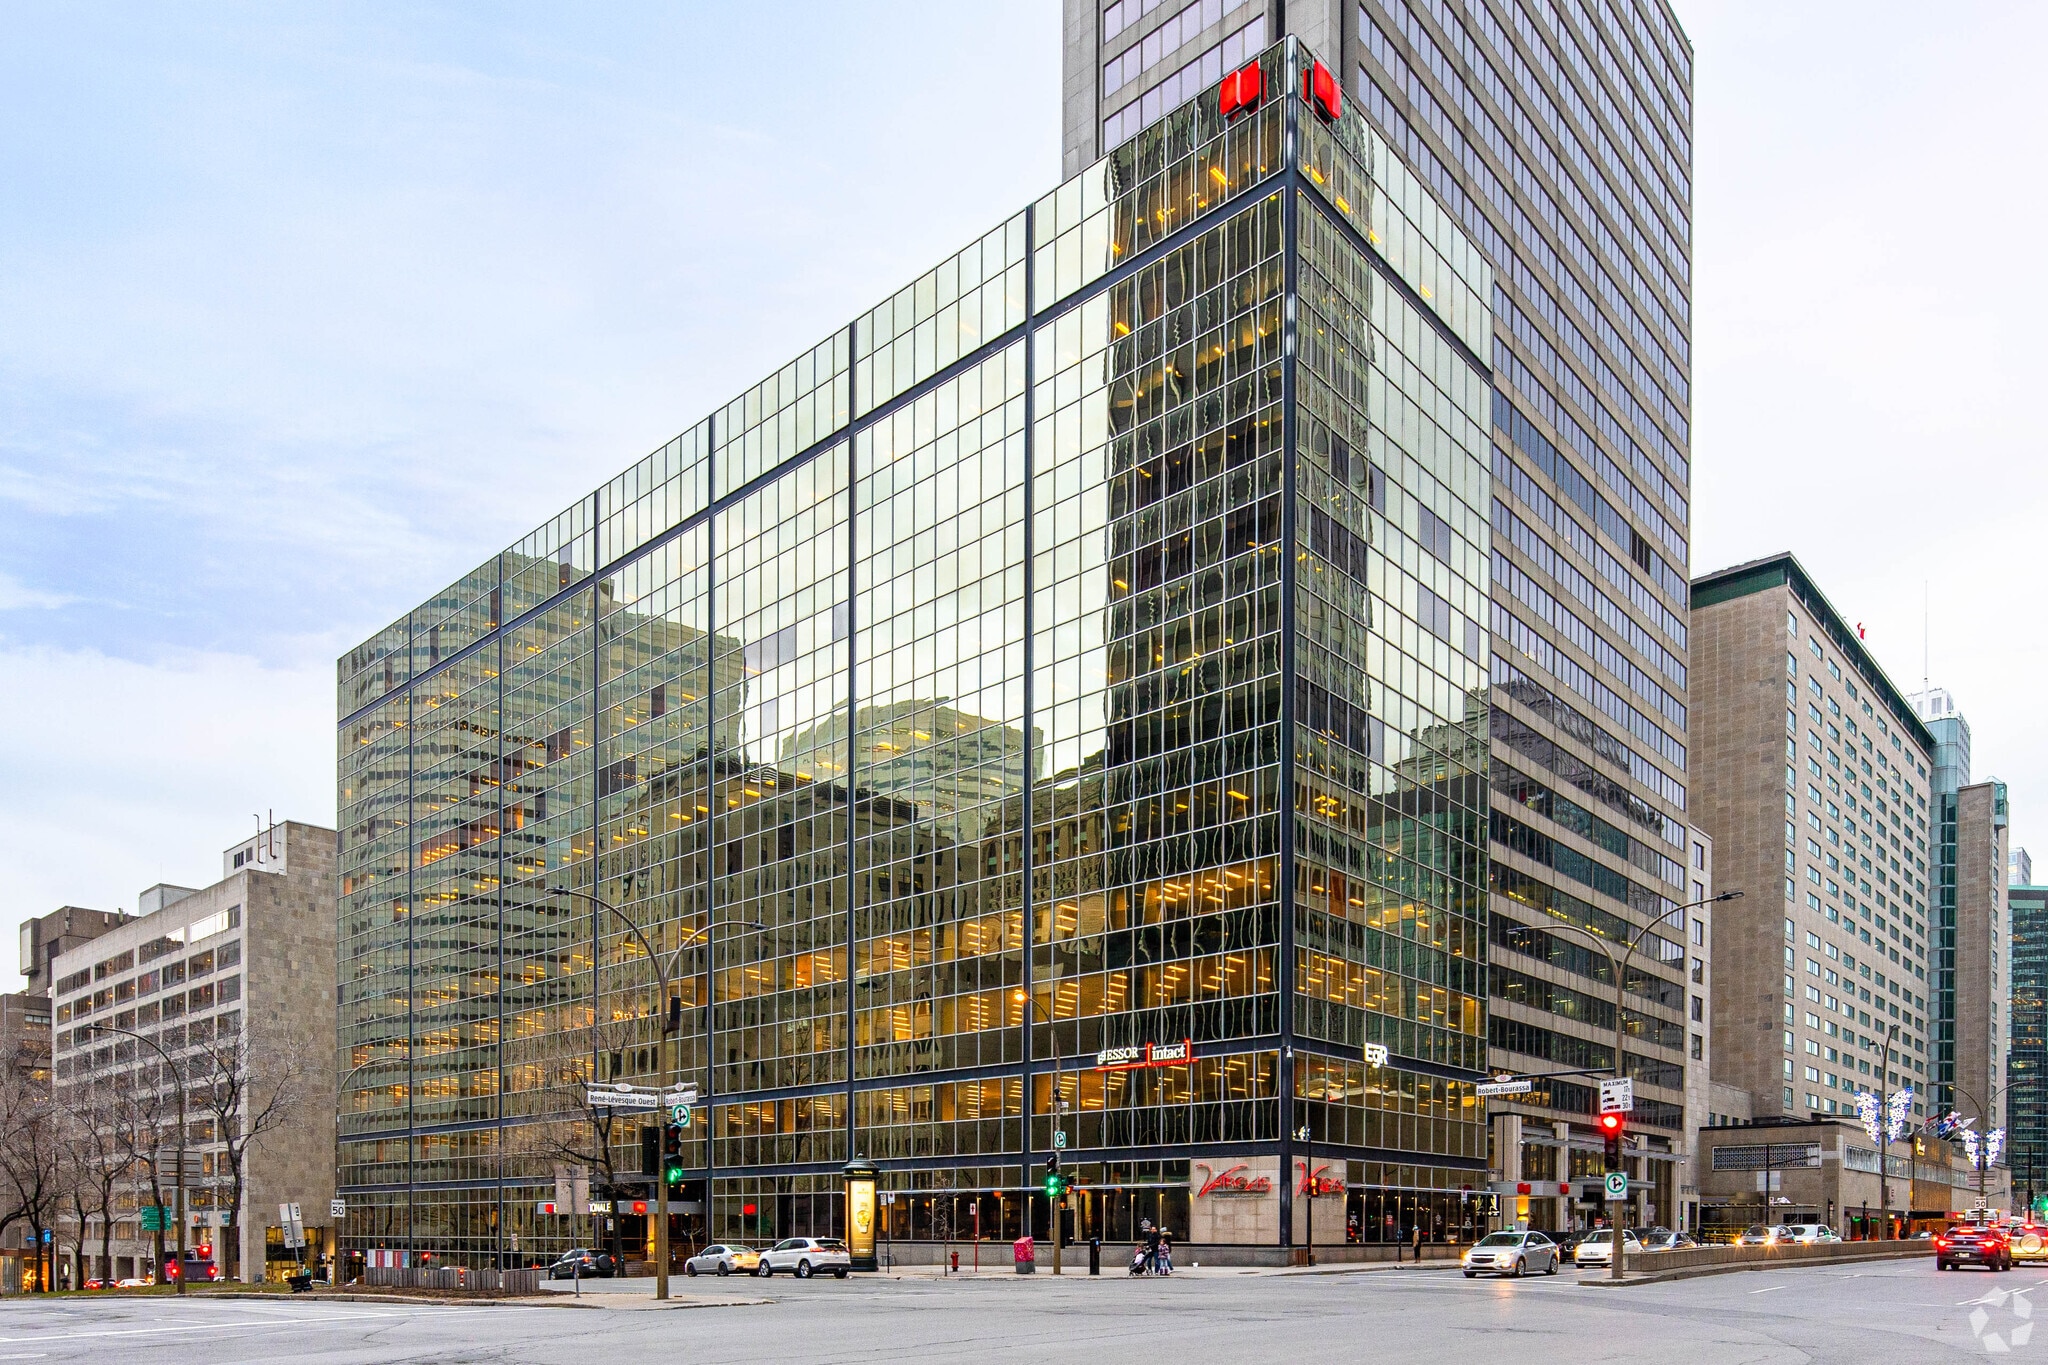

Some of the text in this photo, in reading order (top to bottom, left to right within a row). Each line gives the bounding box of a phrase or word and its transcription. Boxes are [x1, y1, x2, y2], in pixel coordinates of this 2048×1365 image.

[1107, 1047, 1139, 1060] ESSOR
[1152, 1045, 1186, 1060] intact
[1478, 1085, 1530, 1094] Robert-Bourassa
[590, 1094, 656, 1106] René-Lévesque Ouest
[332, 1206, 344, 1215] 50
